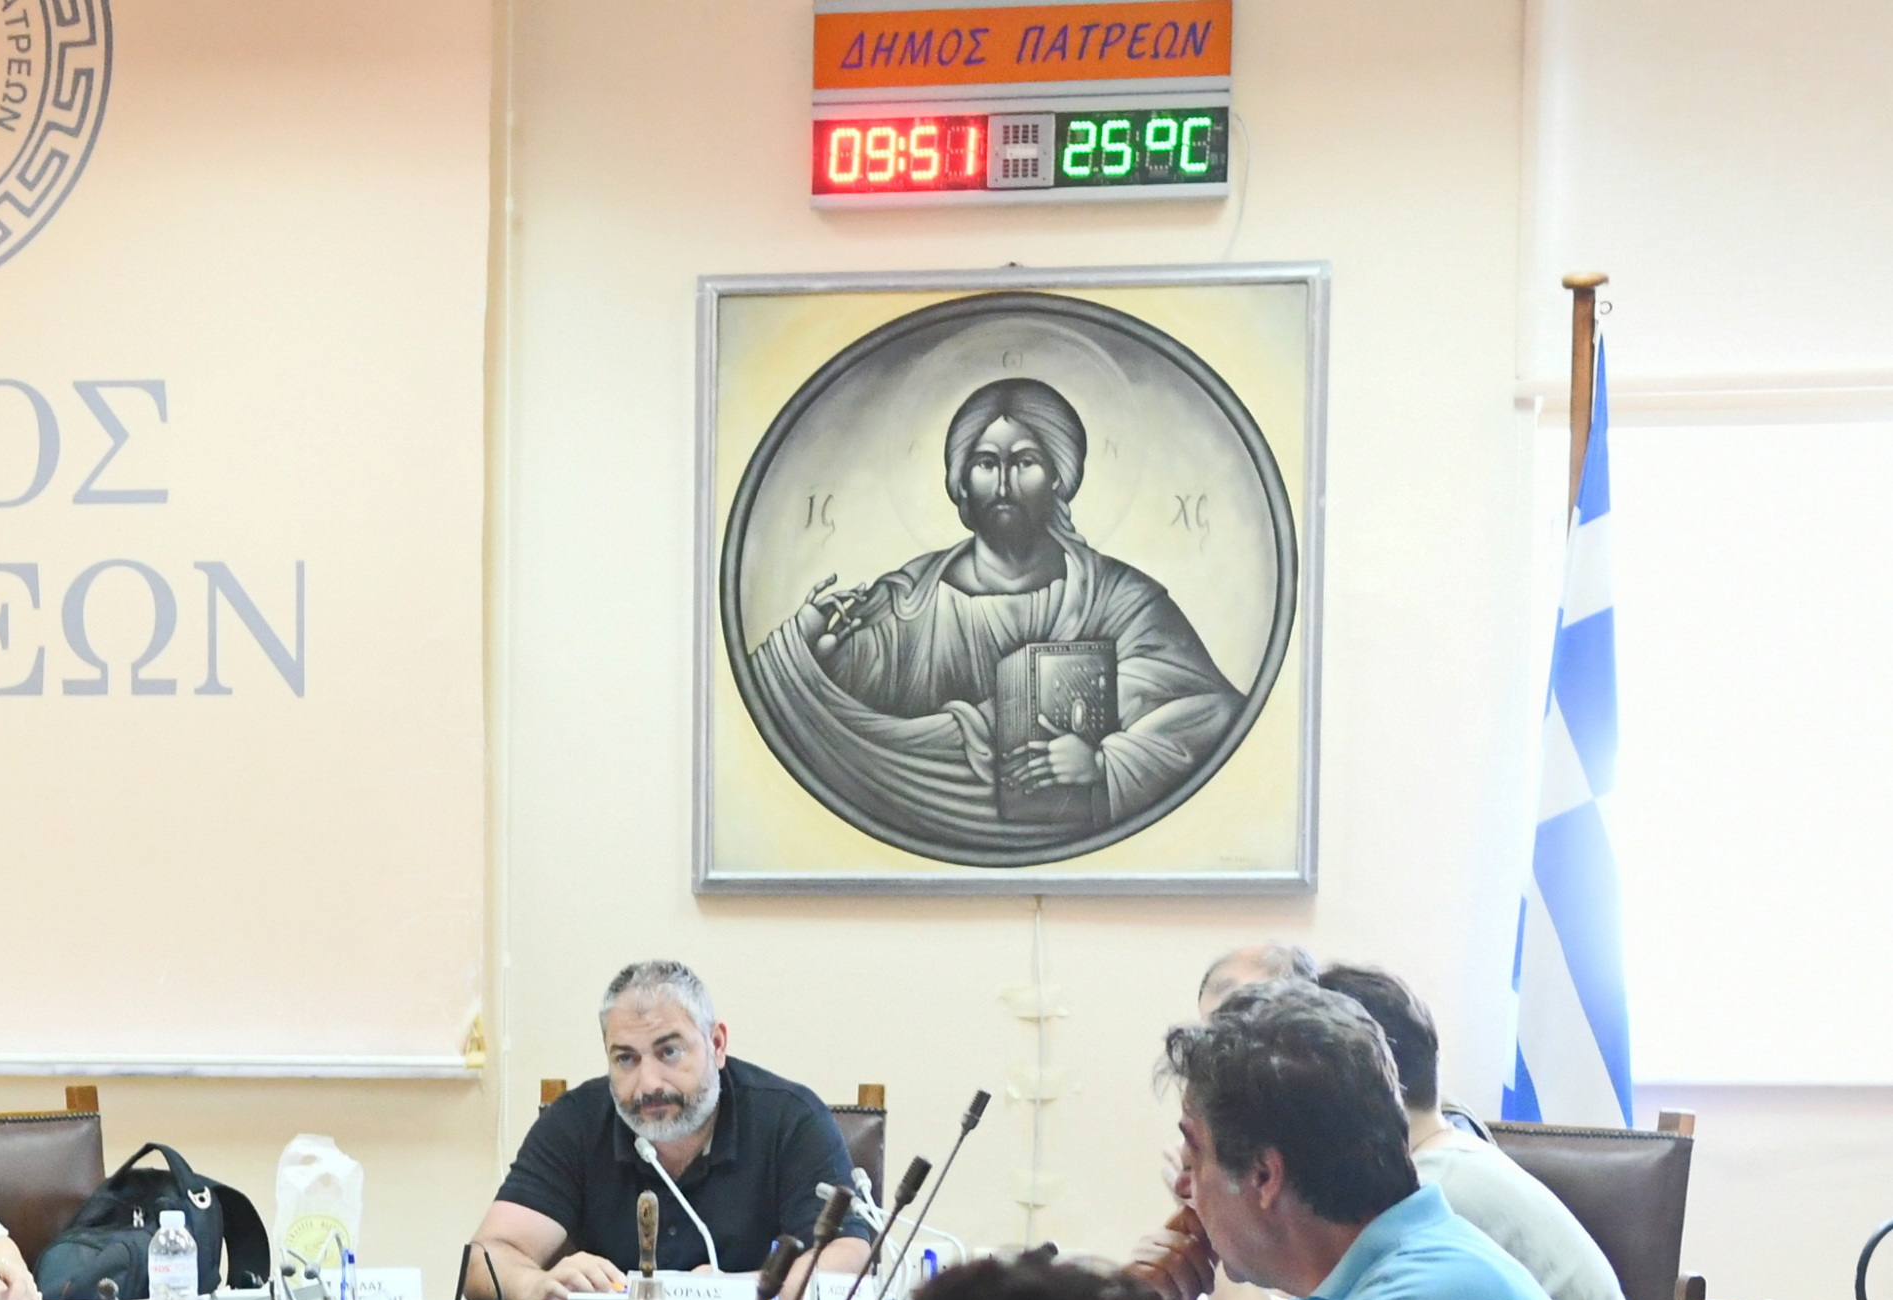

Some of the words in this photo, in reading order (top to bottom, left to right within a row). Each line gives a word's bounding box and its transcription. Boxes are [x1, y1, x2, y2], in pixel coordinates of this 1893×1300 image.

[840, 27, 991, 70] ΔΗΜΟΣ
[1015, 20, 1212, 64] ΠΑΤΡΕΩΝ
[828, 123, 981, 183] 09:51
